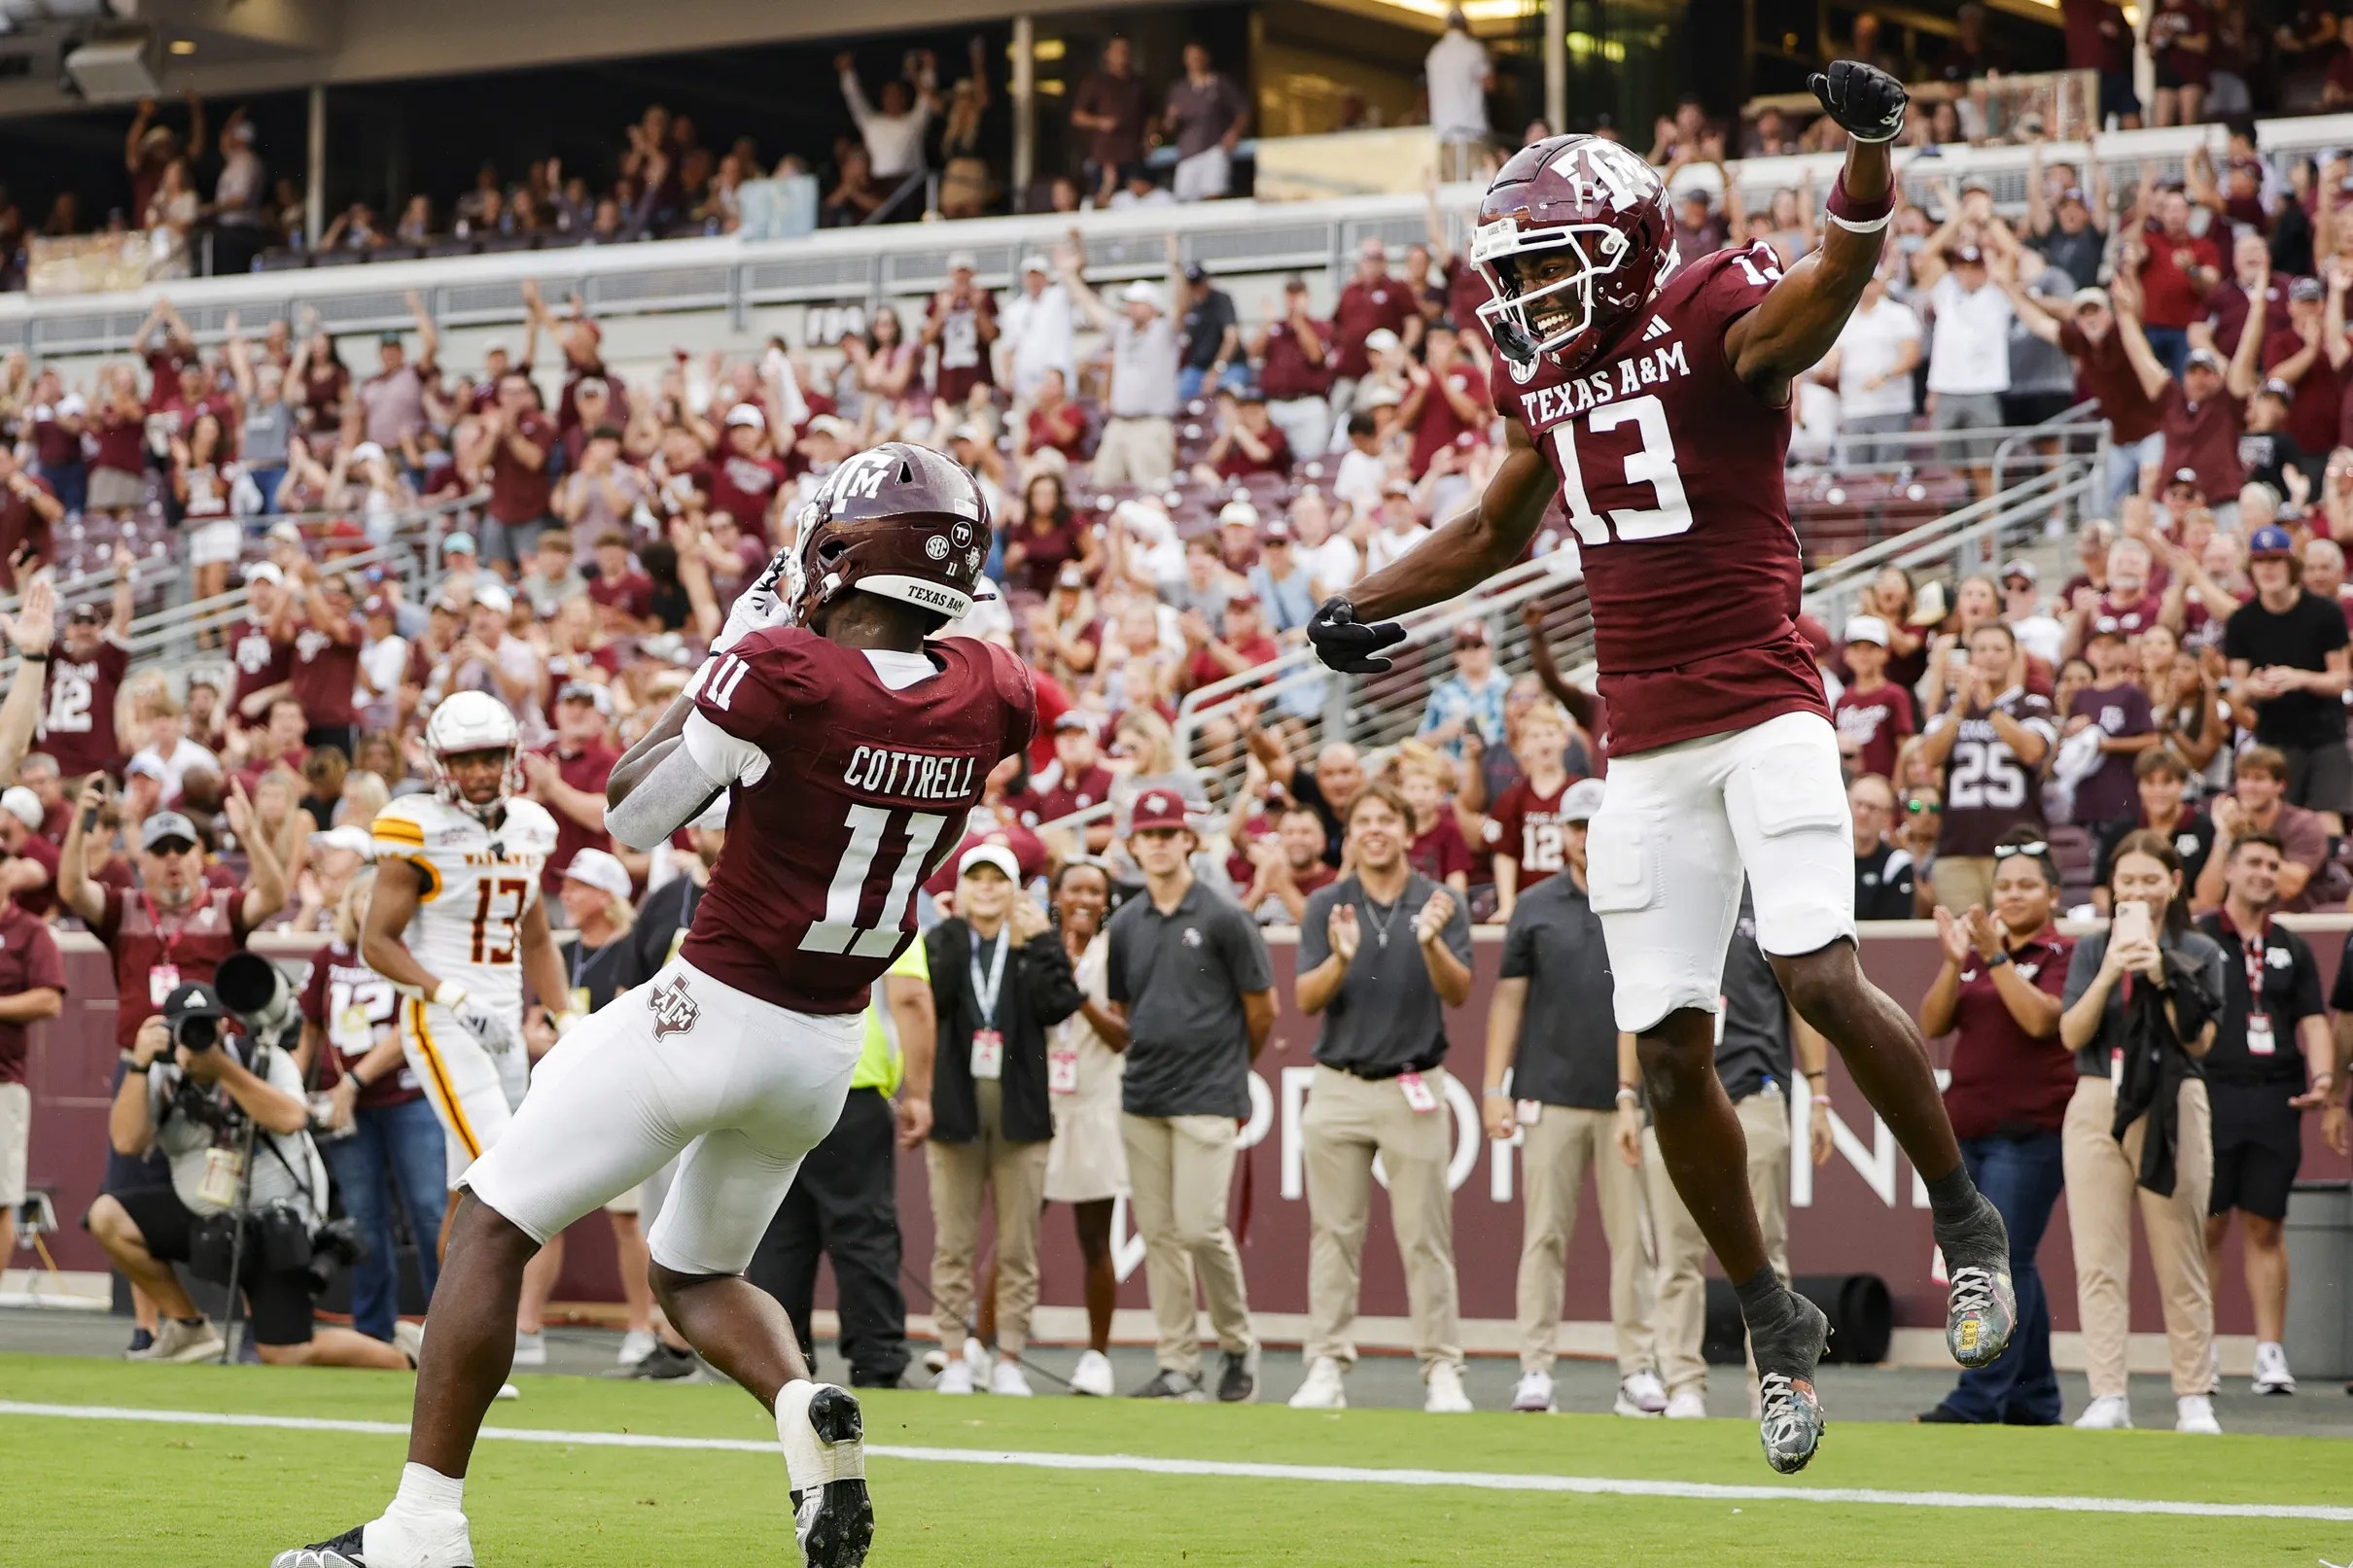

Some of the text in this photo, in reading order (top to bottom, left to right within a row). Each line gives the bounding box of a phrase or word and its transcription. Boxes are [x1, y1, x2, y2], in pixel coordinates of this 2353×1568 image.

[1520, 341, 1691, 427] TEXAS A&M
[1544, 394, 1694, 545] 13
[929, 540, 947, 558] SEC
[956, 526, 969, 540] TP
[945, 562, 958, 576] 11
[908, 585, 966, 612] TEXAS A&M
[706, 653, 751, 712] 11
[844, 746, 975, 798] COTTRELL
[1949, 740, 2026, 809] 25
[1522, 823, 1564, 872] 12
[797, 804, 948, 958] 11
[472, 879, 527, 963] 13
